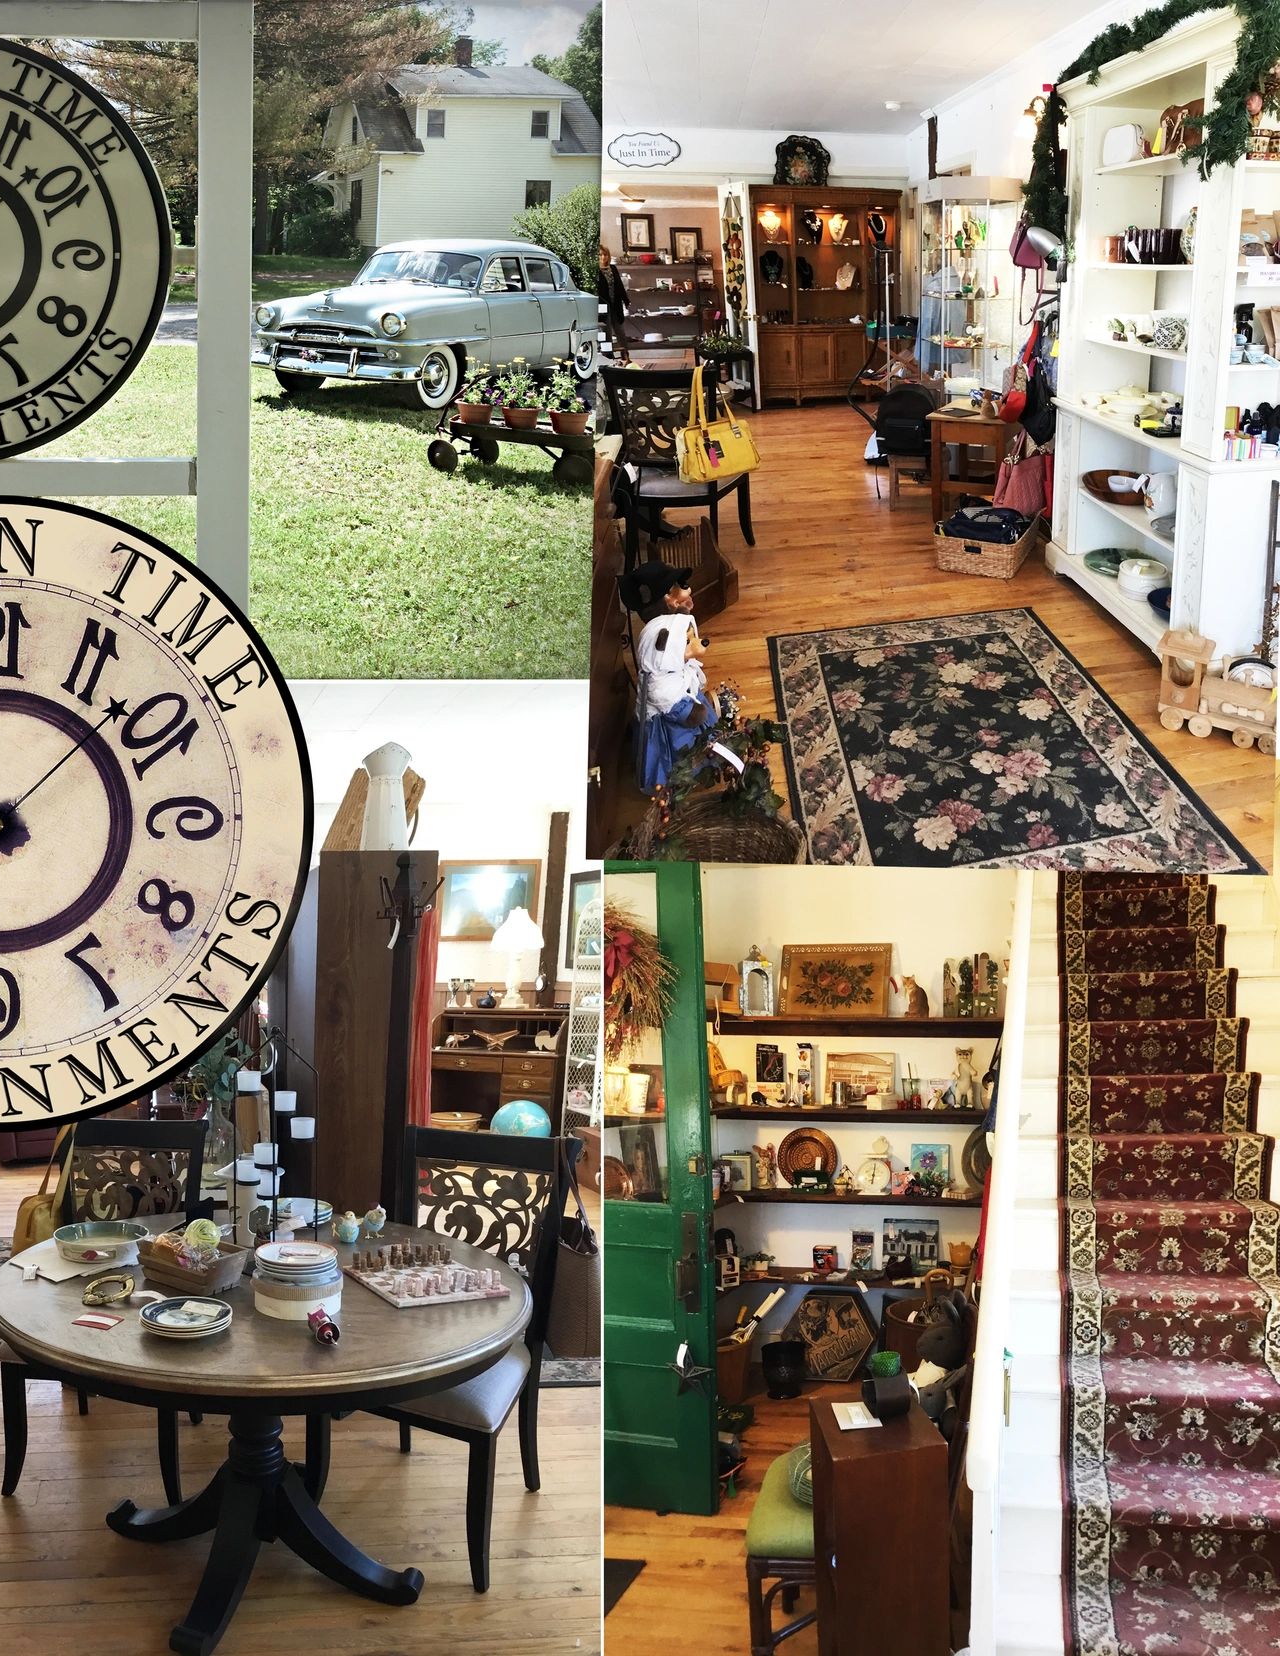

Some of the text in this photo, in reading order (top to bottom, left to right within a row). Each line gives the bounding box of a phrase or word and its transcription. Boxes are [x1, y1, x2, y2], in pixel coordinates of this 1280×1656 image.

[9, 59, 126, 166] TIME
[620, 148, 671, 158] Just In Time
